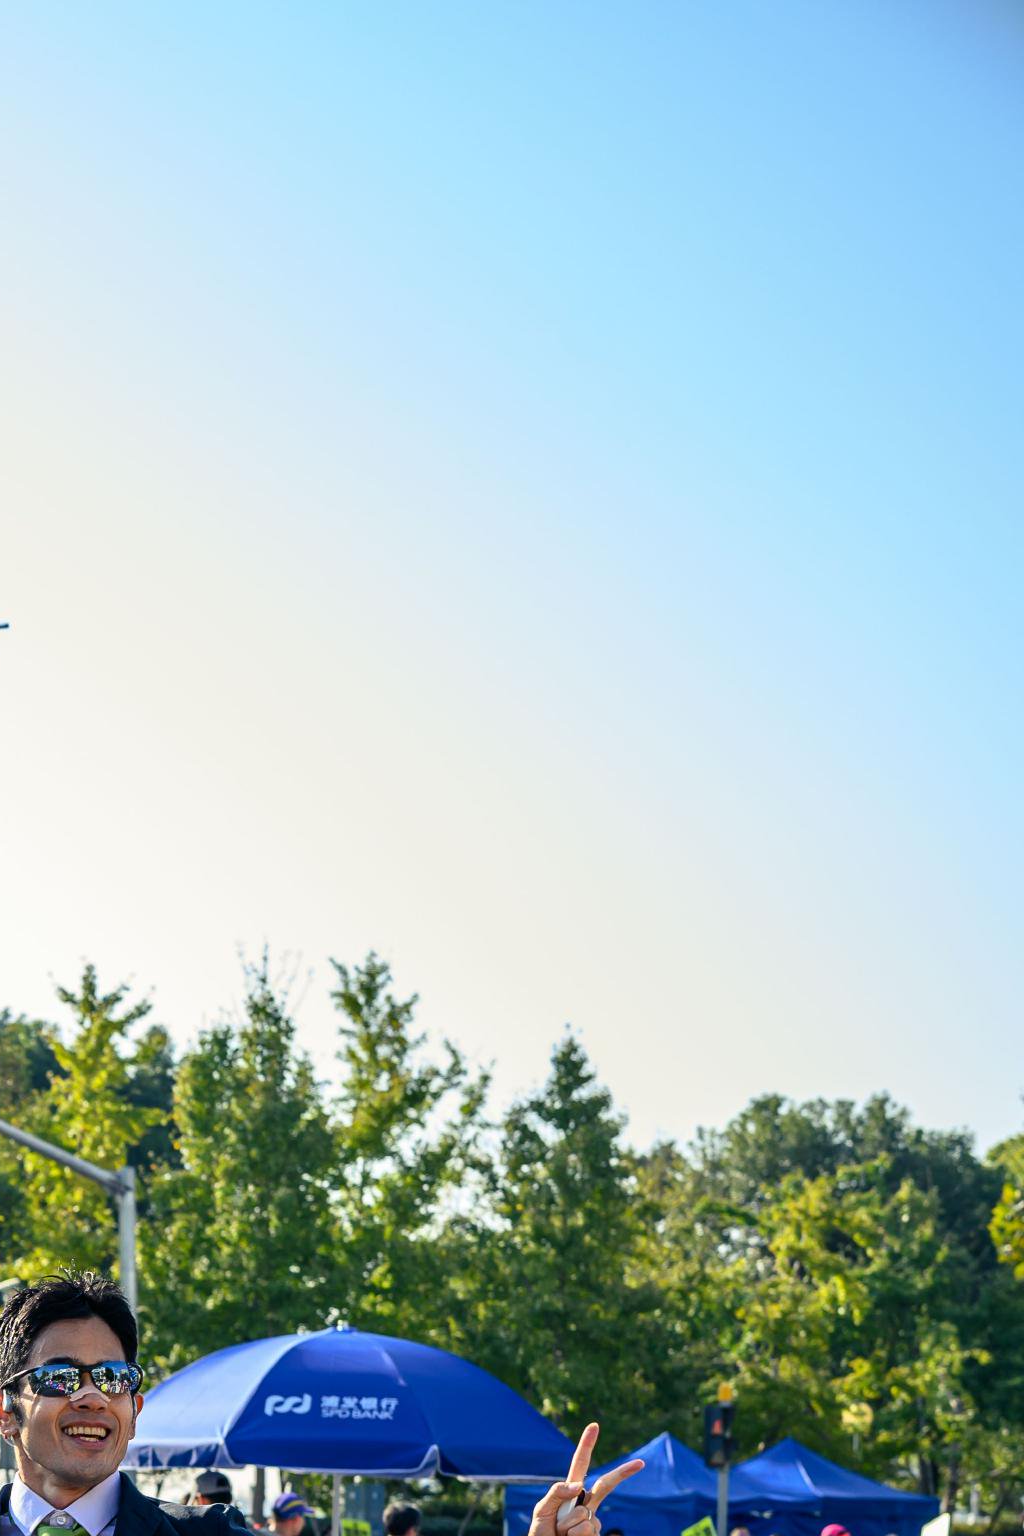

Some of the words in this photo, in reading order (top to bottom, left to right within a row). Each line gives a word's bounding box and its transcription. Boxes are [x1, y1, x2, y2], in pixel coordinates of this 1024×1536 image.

[320, 1395, 399, 1412] 浦发银行
[321, 1408, 350, 1418] SPD
[352, 1409, 394, 1420] BANK
